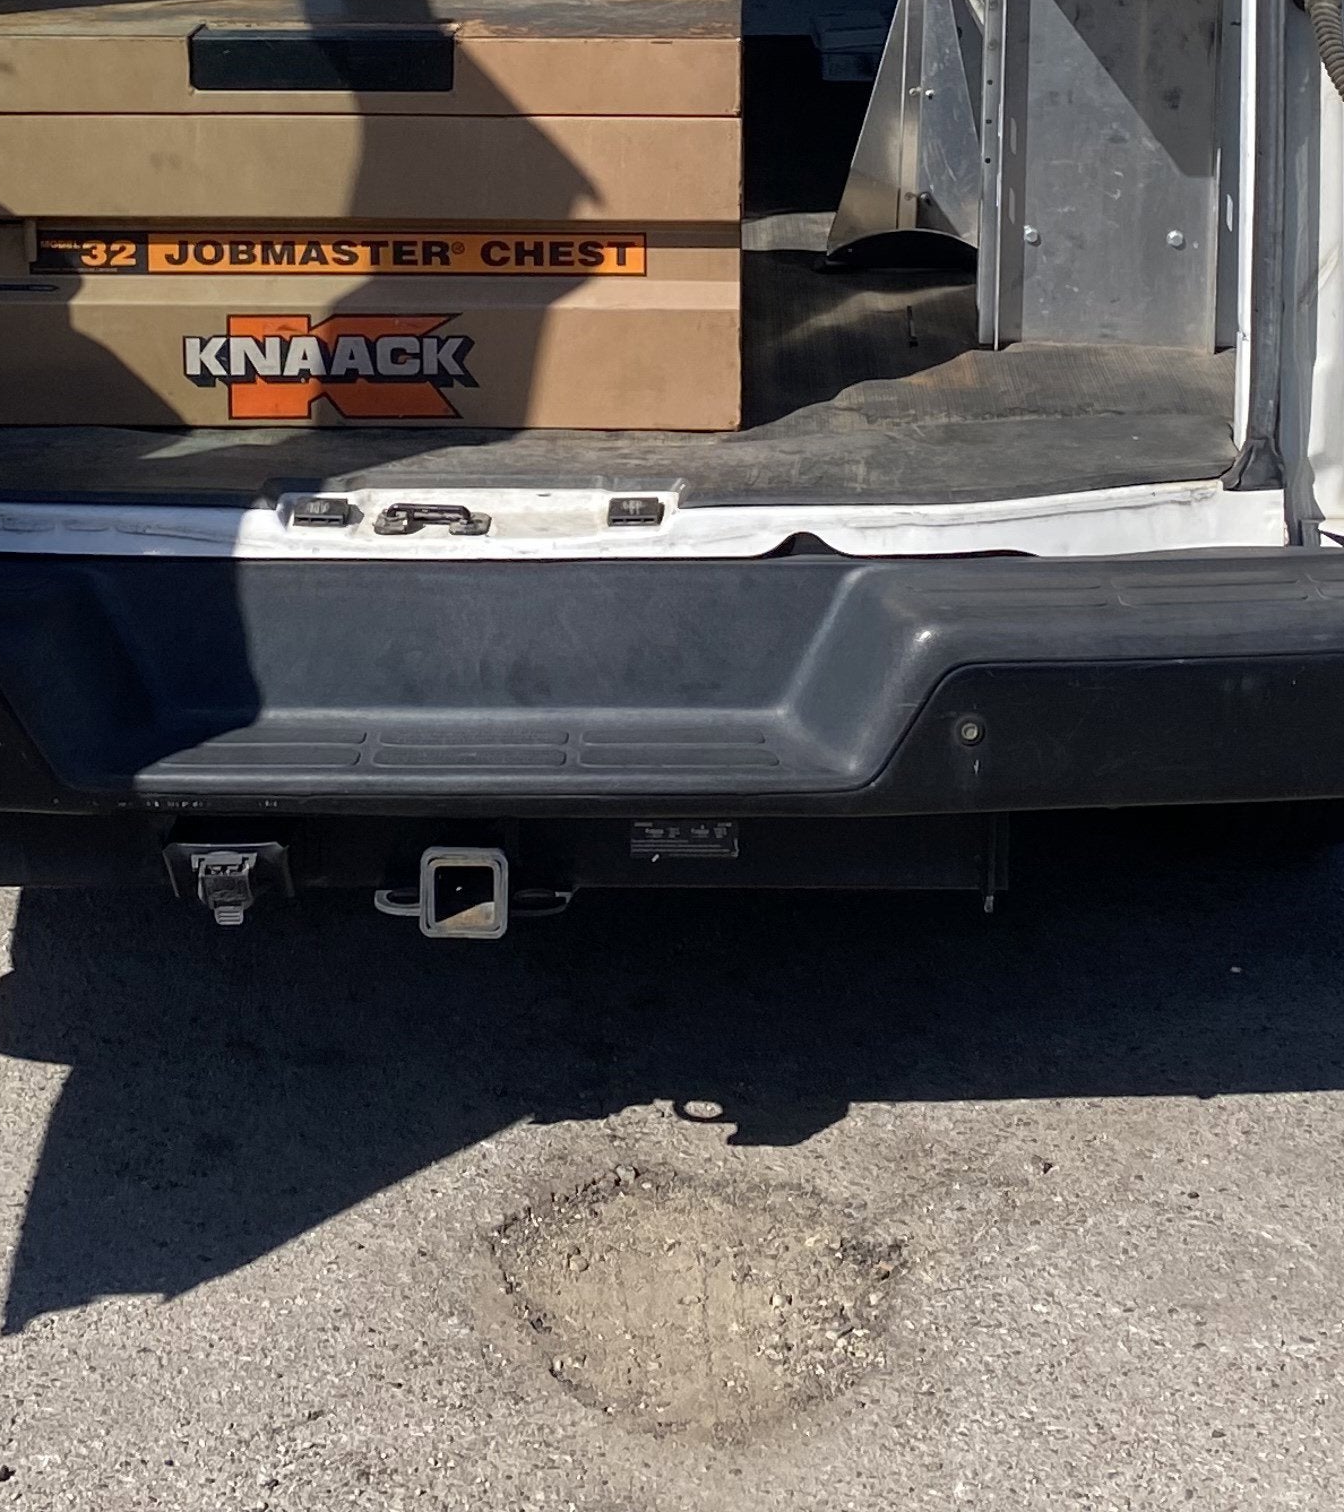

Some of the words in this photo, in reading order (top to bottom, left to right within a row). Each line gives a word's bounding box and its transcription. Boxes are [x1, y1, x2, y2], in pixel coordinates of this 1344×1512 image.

[80, 240, 137, 266] 32
[480, 240, 636, 266] CHEST
[183, 335, 476, 386] KNAACK
